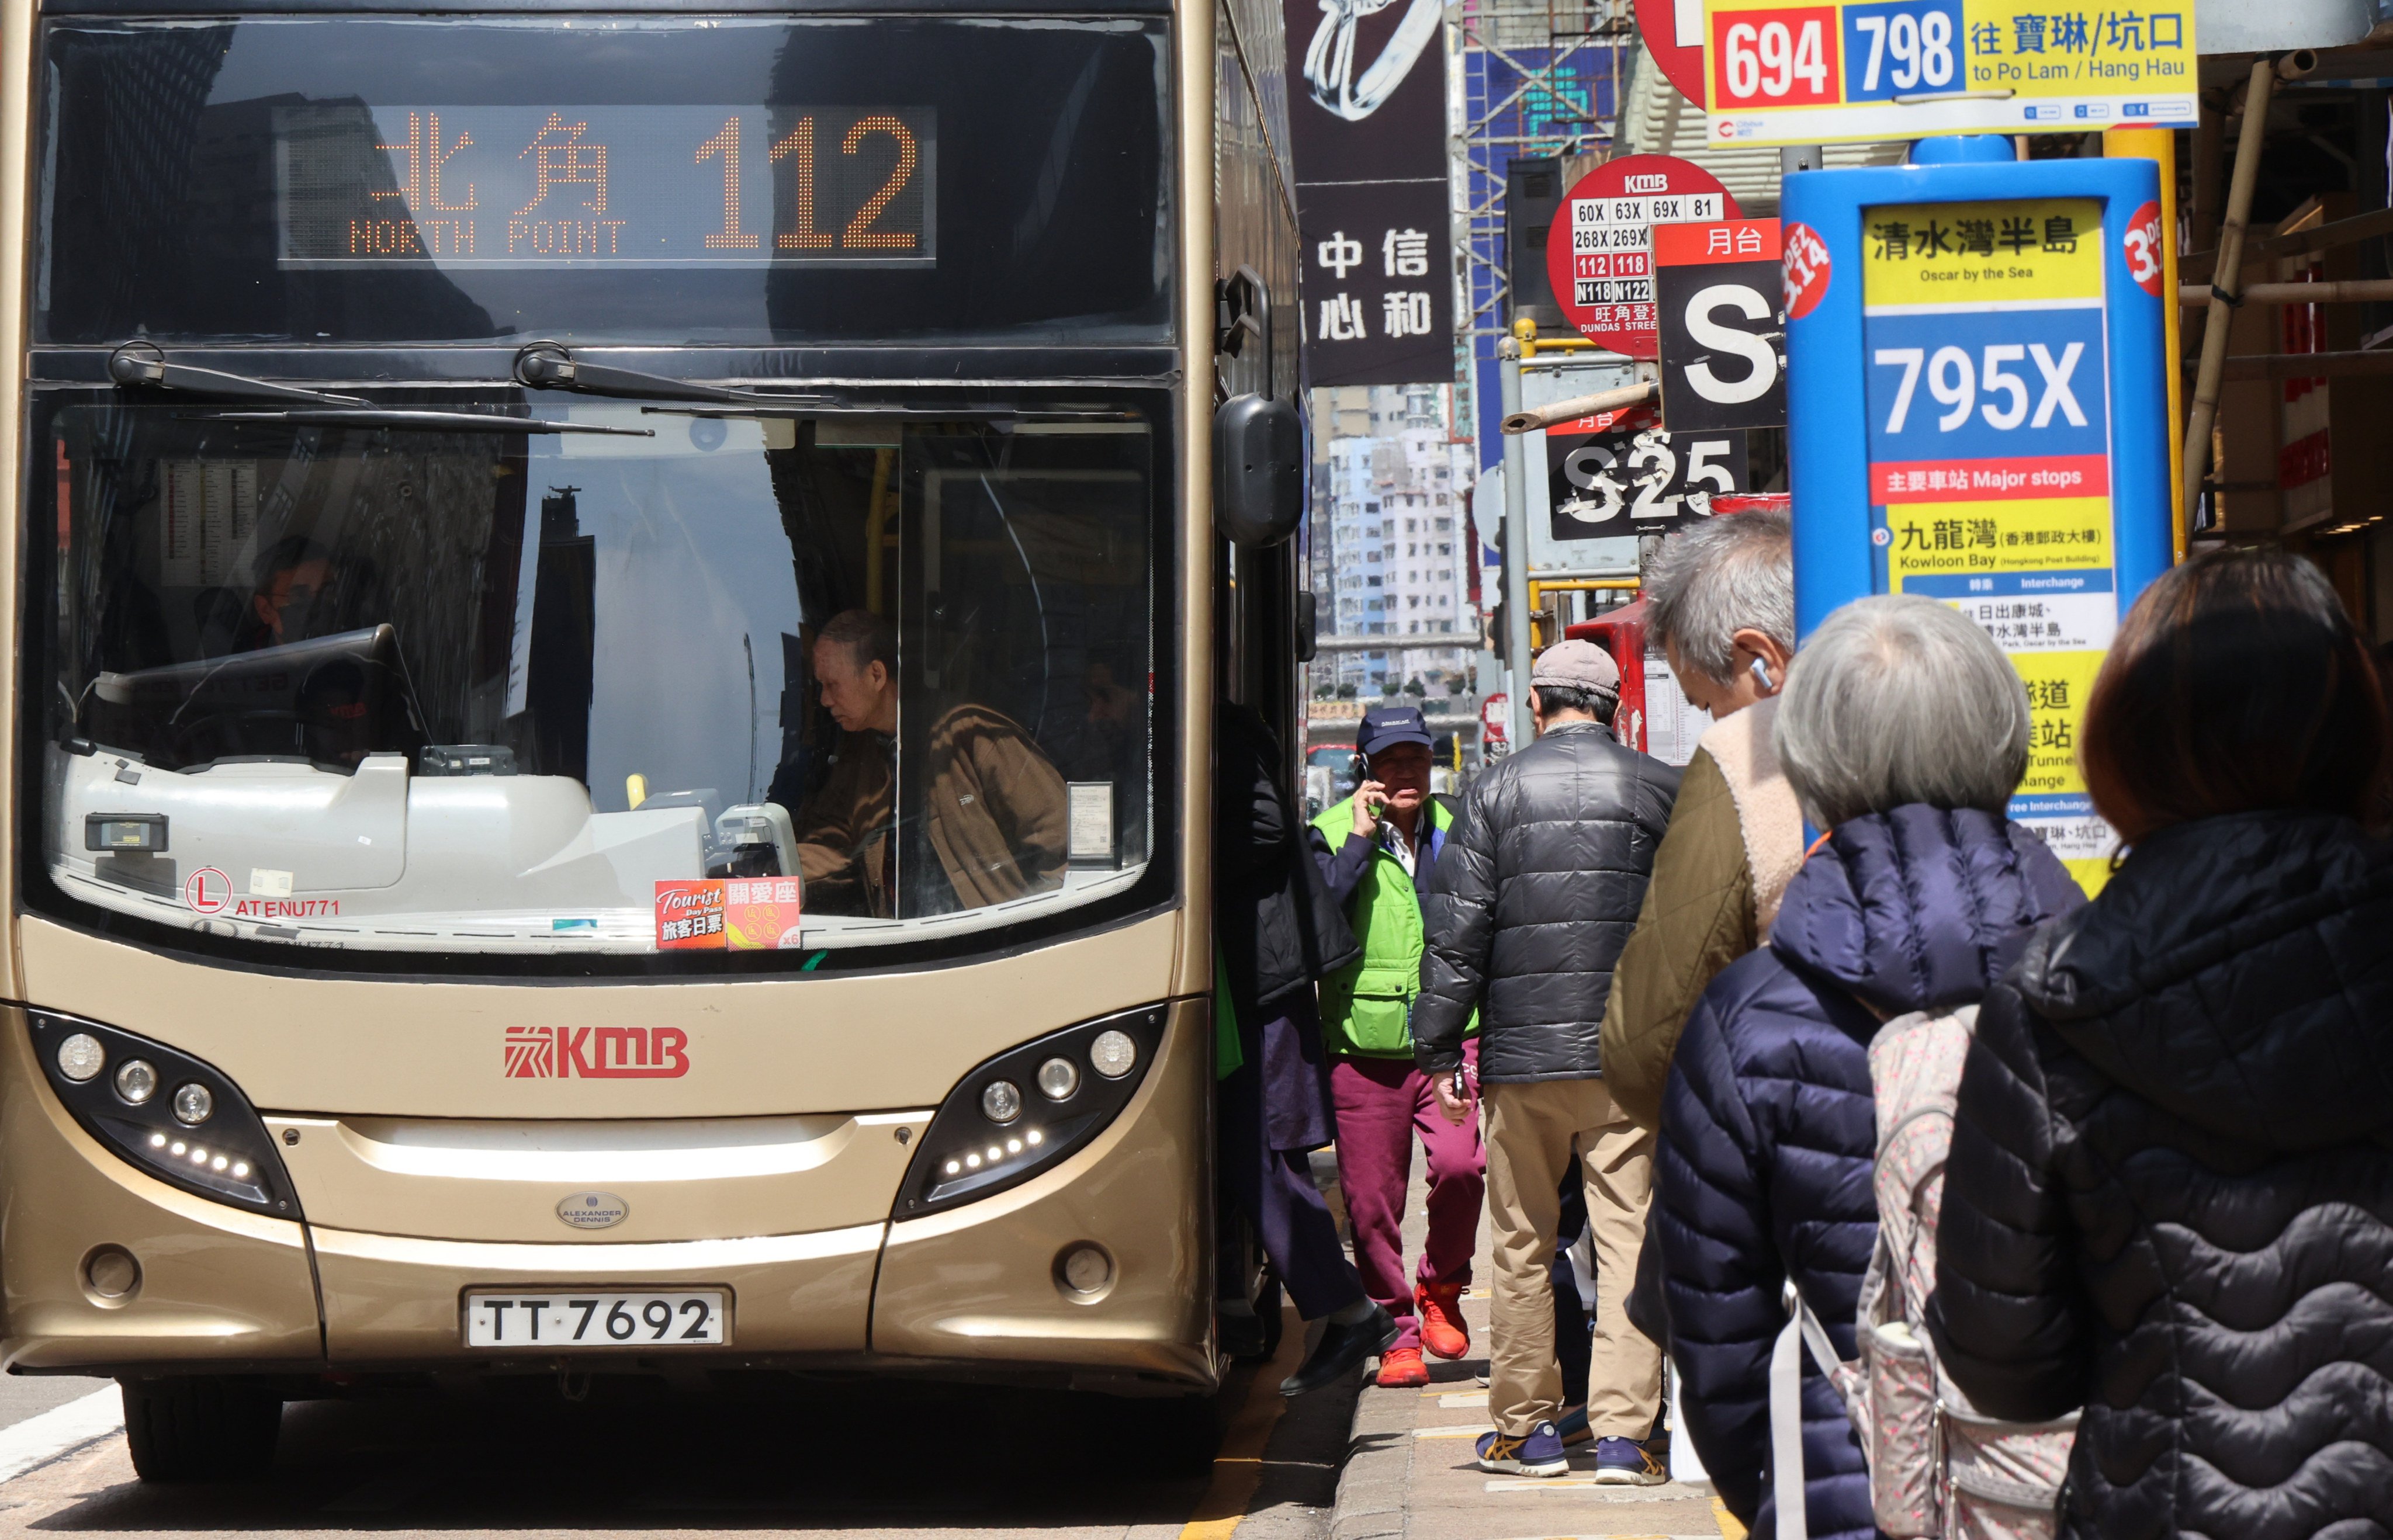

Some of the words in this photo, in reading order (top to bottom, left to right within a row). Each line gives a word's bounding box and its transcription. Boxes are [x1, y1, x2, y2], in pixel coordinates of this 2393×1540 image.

[1971, 22, 2002, 56] 往
[2013, 10, 2183, 57] 寶琳/坑口
[1726, 20, 1827, 98] 694
[1855, 11, 1954, 91] 798
[1973, 65, 1992, 81] to
[1997, 63, 2022, 80] Po
[2028, 62, 2069, 79] Lam
[2075, 61, 2083, 80] /
[2089, 60, 2139, 81] Hang
[2146, 58, 2185, 75] Hau
[372, 112, 608, 216] 北角
[695, 117, 916, 249] 112
[1625, 174, 1668, 193] KMB
[1579, 204, 1604, 222] 60X
[1615, 202, 1641, 220] 63X
[1653, 200, 1679, 218] 69X
[1695, 199, 1711, 216] 81
[350, 220, 475, 253] NORTH
[508, 220, 627, 253] POINT
[1575, 230, 1609, 248] 268X
[1613, 228, 1647, 247] 269X
[1707, 227, 1762, 255] 月台
[1873, 215, 2079, 261] 清水灣半島
[1579, 256, 1606, 275] 112
[1617, 255, 1644, 273] 118
[1920, 270, 1958, 282] Oscar
[1963, 268, 1978, 283] by
[1983, 267, 2004, 280] the
[2008, 266, 2034, 279] Sea
[1577, 283, 1611, 301] N118
[1615, 280, 1649, 300] N122
[1581, 323, 1620, 333] DUNDAS
[1685, 284, 1778, 404] S
[1875, 342, 2089, 433] 795X
[1578, 411, 1614, 428] 月台
[1564, 439, 1735, 523] S25
[1887, 469, 1968, 492] 主要車站
[1973, 471, 2026, 491] Major
[2031, 469, 2082, 488] stops
[1900, 518, 1997, 552] 九龍灣
[1900, 556, 1964, 569] Kowloon
[1969, 553, 1996, 569] Bay
[2021, 577, 2084, 589] Interchange
[198, 876, 219, 906] L
[656, 887, 722, 915] Tourist
[728, 881, 797, 905] 關愛座
[235, 900, 340, 917] ATENU771
[686, 907, 703, 917] Day
[704, 905, 723, 915] Pass
[662, 914, 723, 941] 旅客日票
[783, 934, 799, 945] x6
[557, 1026, 690, 1078] KMB
[484, 1300, 550, 1340] TT
[569, 1299, 710, 1340] 7692
